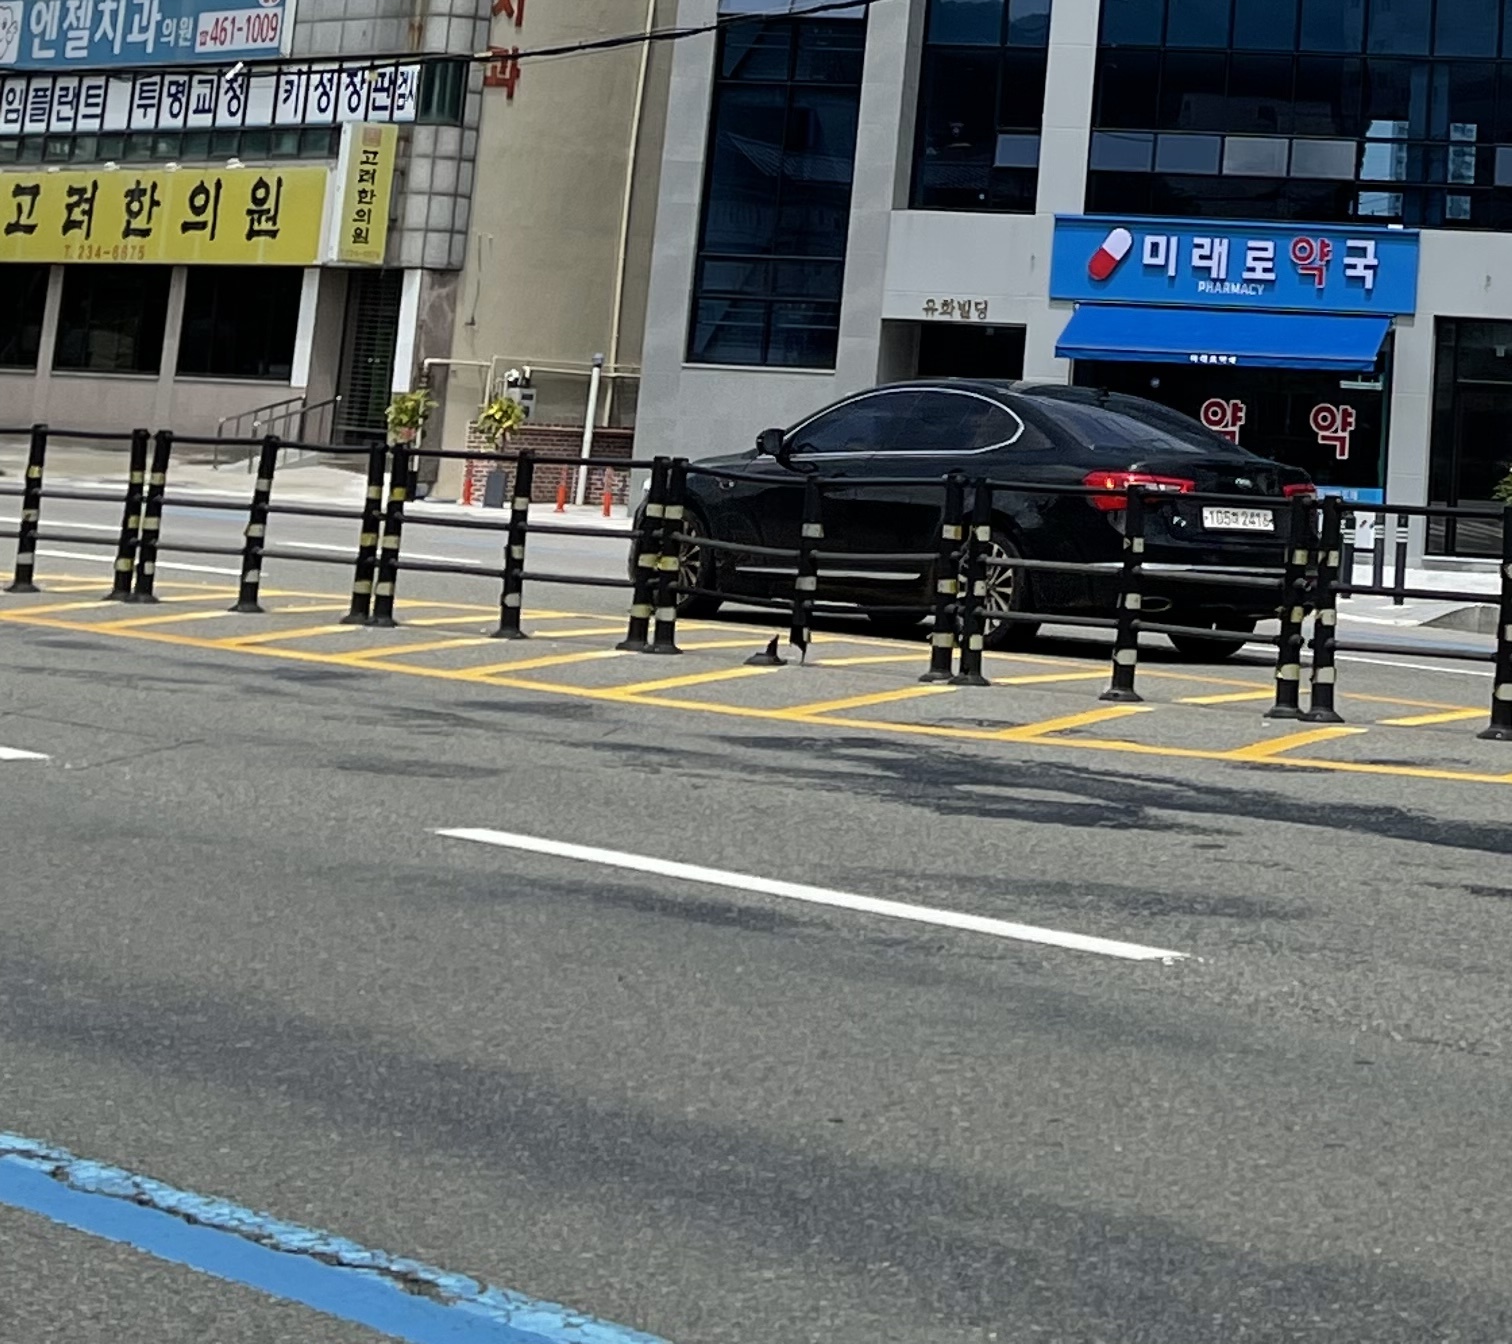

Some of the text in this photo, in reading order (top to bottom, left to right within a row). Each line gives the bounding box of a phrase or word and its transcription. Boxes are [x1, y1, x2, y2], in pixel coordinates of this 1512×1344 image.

[209, 12, 279, 46] 461-1009
[4, 77, 102, 125] 임플란트
[136, 71, 244, 120] 투명교정
[4, 176, 284, 242] 고려한의원
[352, 149, 379, 245] 고려한의원
[1142, 232, 1380, 290] 미래로약국
[1197, 280, 1266, 296] PHARMACY
[1310, 403, 1356, 461] 약
